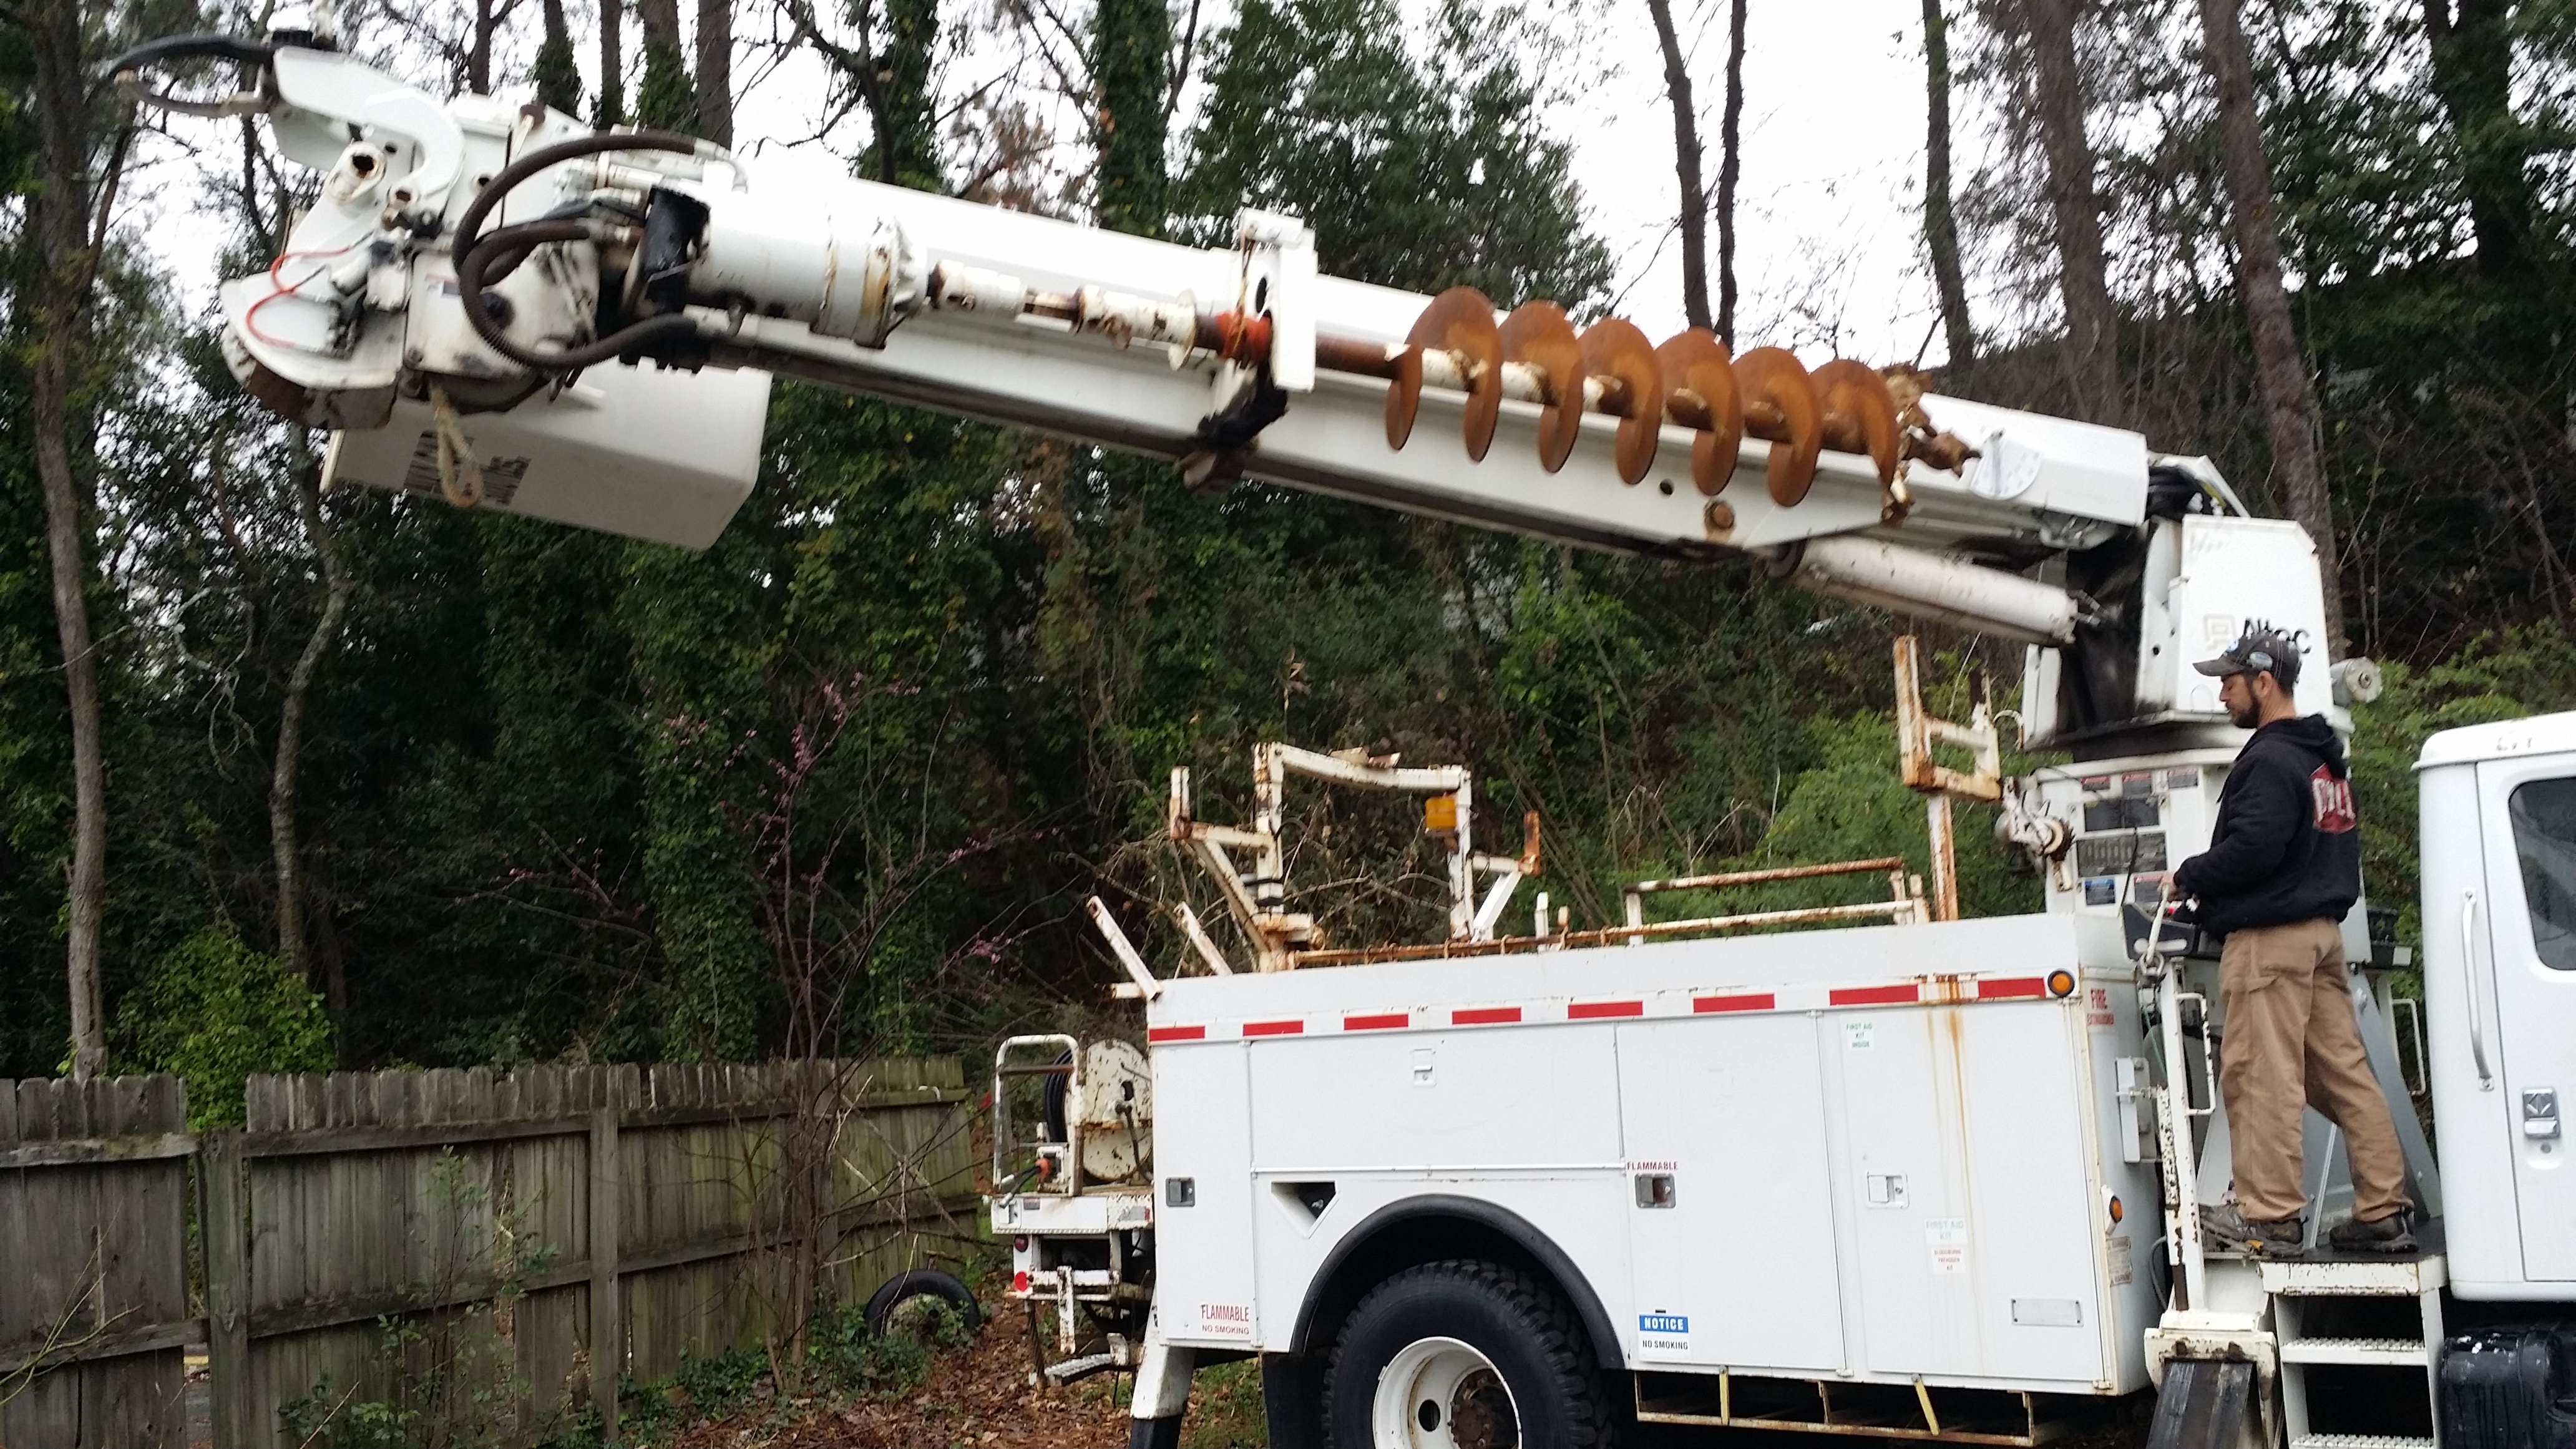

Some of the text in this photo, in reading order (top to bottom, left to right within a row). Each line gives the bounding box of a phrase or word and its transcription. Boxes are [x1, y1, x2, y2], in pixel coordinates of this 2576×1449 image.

[1626, 1161, 1678, 1171] FLAMMABLE
[1926, 1220, 1964, 1229] FIRST AID
[1939, 1231, 1951, 1241] KIT
[1201, 1304, 1249, 1322] FLAMMABLE
[1644, 1317, 1684, 1330] NOTICE
[1202, 1324, 1249, 1335] NO SMOKING
[1642, 1340, 1688, 1350] NO SMOKING
